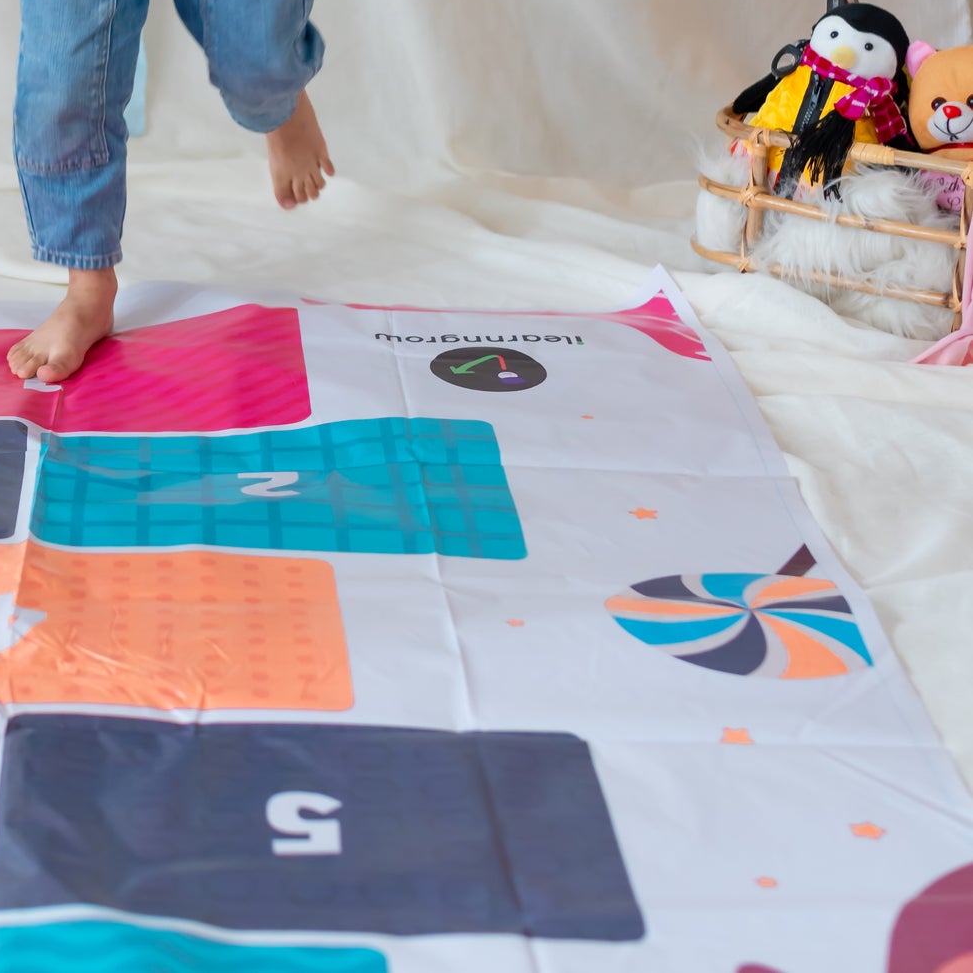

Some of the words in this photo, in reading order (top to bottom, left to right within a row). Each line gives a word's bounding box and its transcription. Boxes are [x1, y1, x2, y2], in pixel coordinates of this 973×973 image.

[375, 331, 583, 346] ilearnngrow
[237, 471, 301, 497] 2
[265, 790, 342, 856] 5
